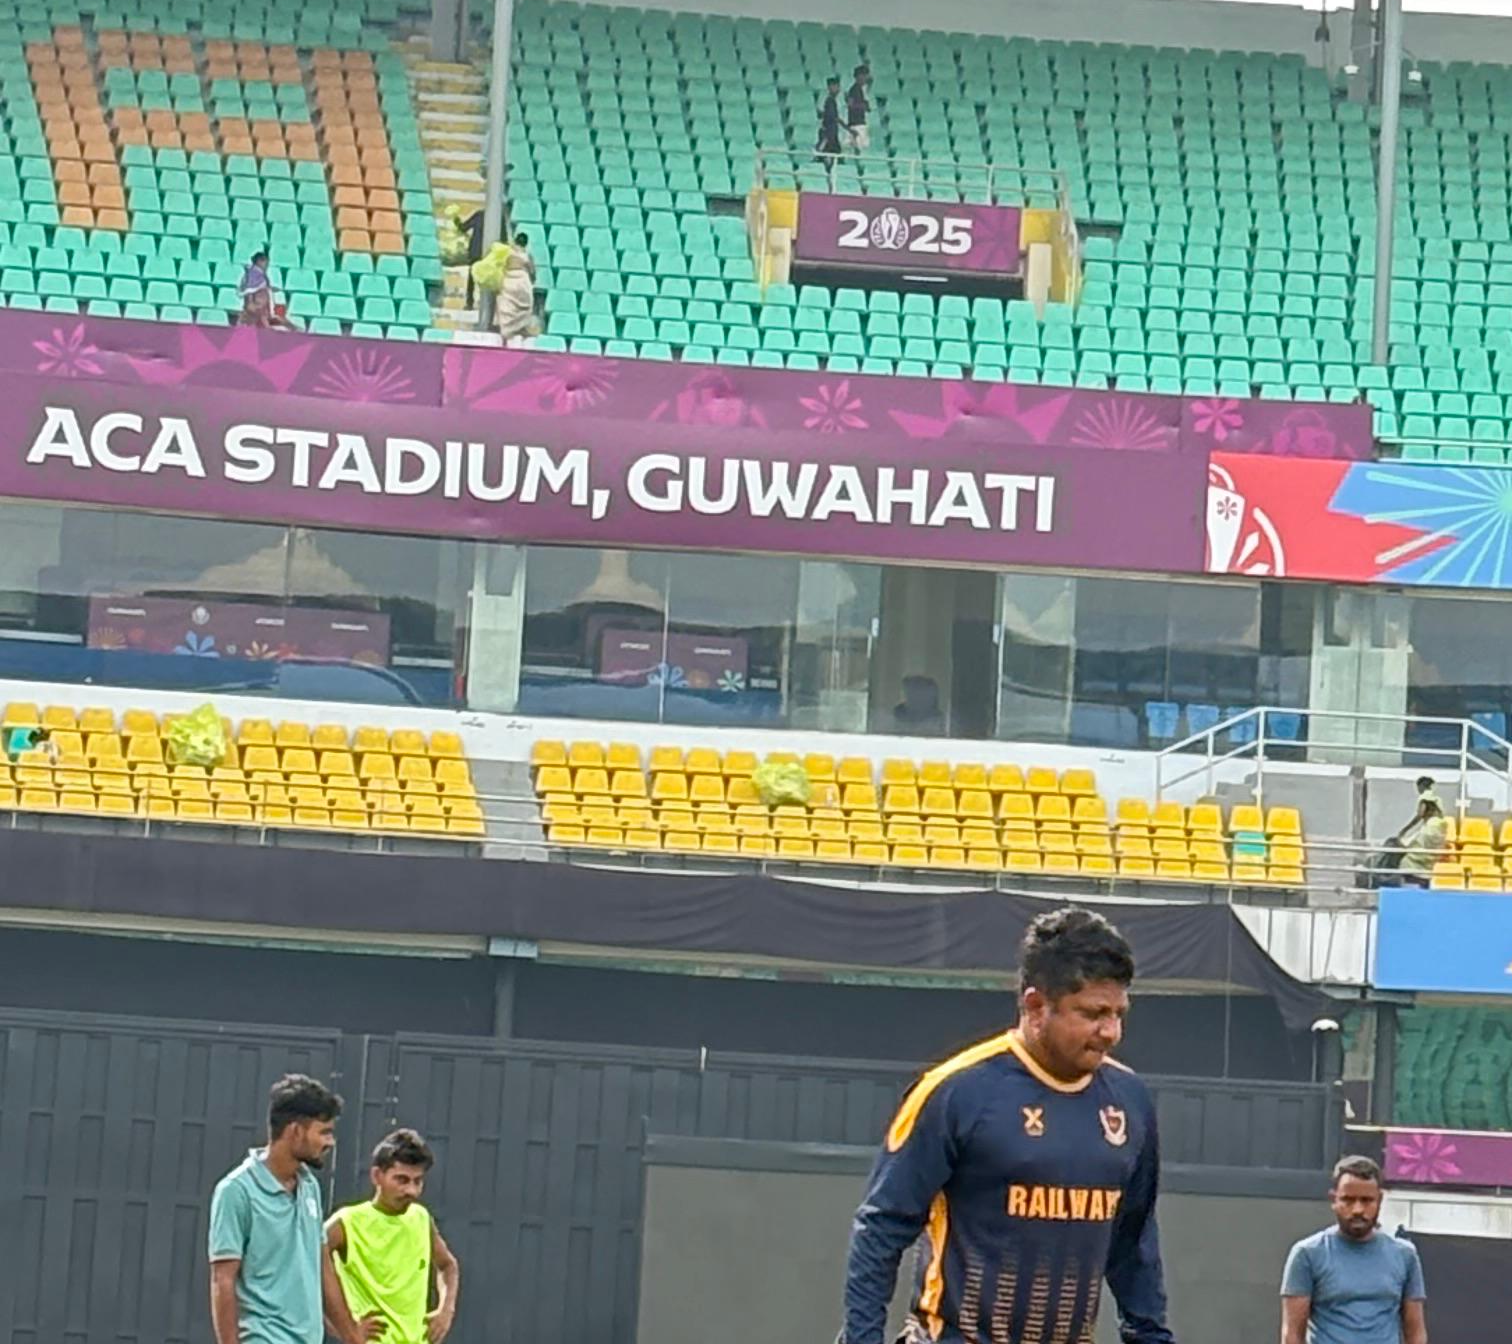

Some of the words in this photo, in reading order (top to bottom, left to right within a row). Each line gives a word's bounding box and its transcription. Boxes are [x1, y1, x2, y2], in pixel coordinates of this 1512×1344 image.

[26, 406, 206, 478] ACA
[223, 424, 610, 520] STADIUM,
[626, 454, 1055, 532] GUWAHATI
